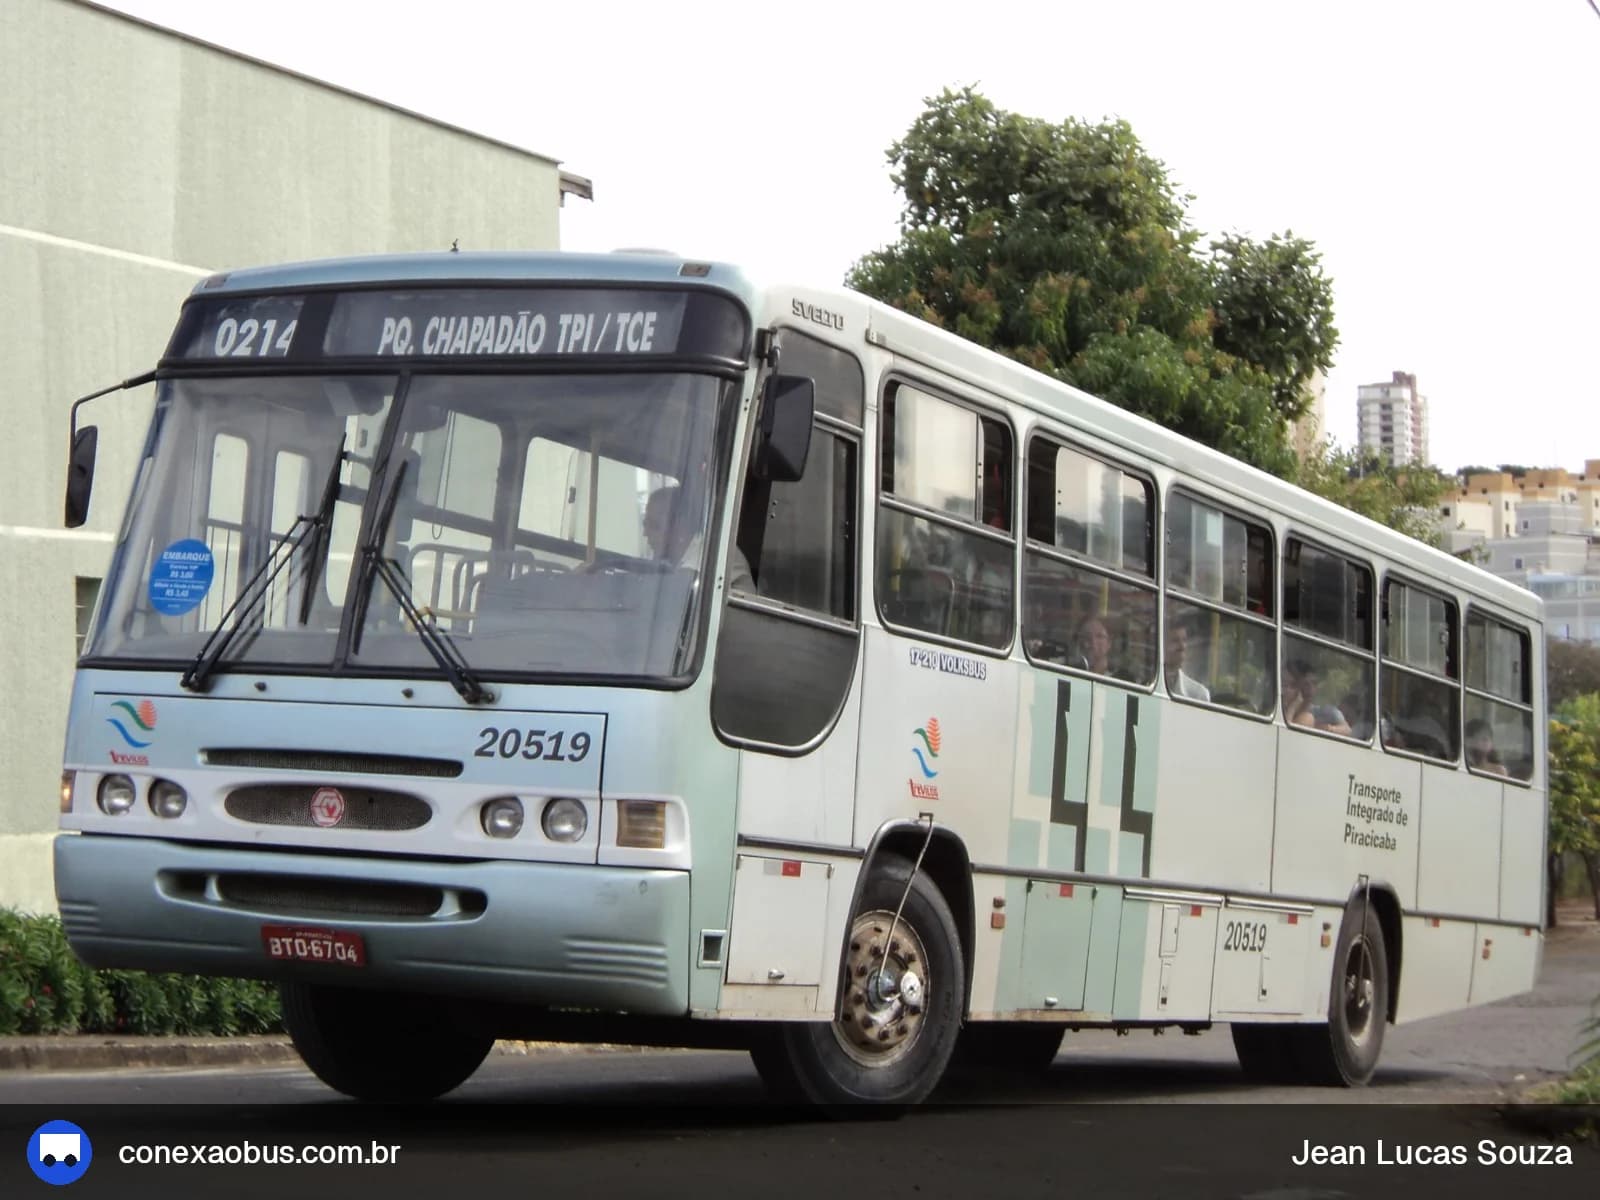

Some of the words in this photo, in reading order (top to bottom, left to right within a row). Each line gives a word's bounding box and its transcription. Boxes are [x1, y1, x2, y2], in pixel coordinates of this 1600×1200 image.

[215, 317, 299, 357] 0214
[377, 316, 415, 356] PQ.
[421, 311, 547, 355] CHAPADÃO
[162, 551, 210, 561] EMBARQUE
[939, 653, 987, 681] VOLKSBUS
[474, 727, 591, 762] 20519
[1348, 774, 1402, 804] Transporte
[1346, 795, 1394, 824] Integrado
[1395, 807, 1408, 826] de
[1343, 822, 1397, 851] Piracicaba
[1224, 921, 1267, 953] 20519
